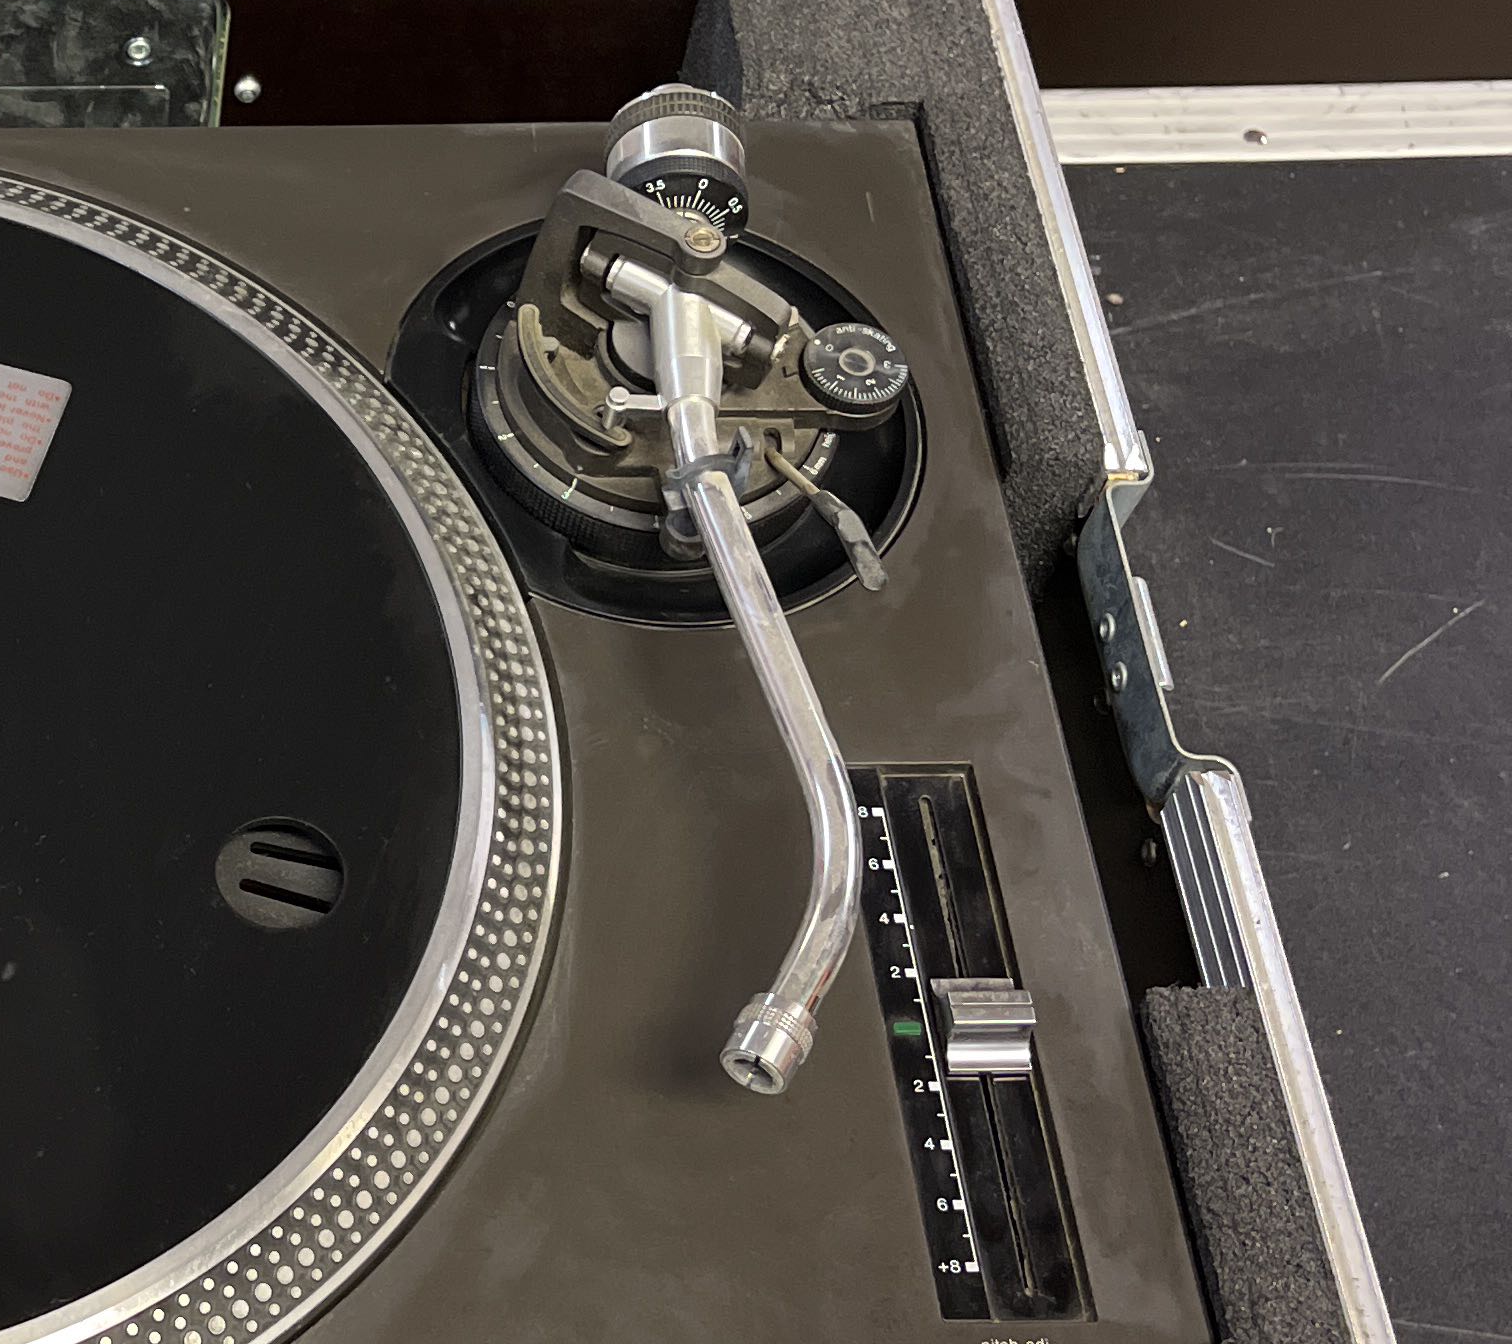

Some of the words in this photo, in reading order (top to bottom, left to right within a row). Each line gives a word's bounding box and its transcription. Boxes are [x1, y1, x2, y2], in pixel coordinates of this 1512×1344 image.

[645, 179, 666, 194] 3.5
[697, 178, 709, 190] 0
[825, 343, 834, 352] 0
[867, 857, 880, 871] 6
[878, 912, 890, 925] 4
[889, 966, 901, 979] 2
[912, 1079, 925, 1093] 2
[924, 1137, 936, 1150] 4
[936, 1197, 948, 1211] 6
[938, 1259, 962, 1274] +8
